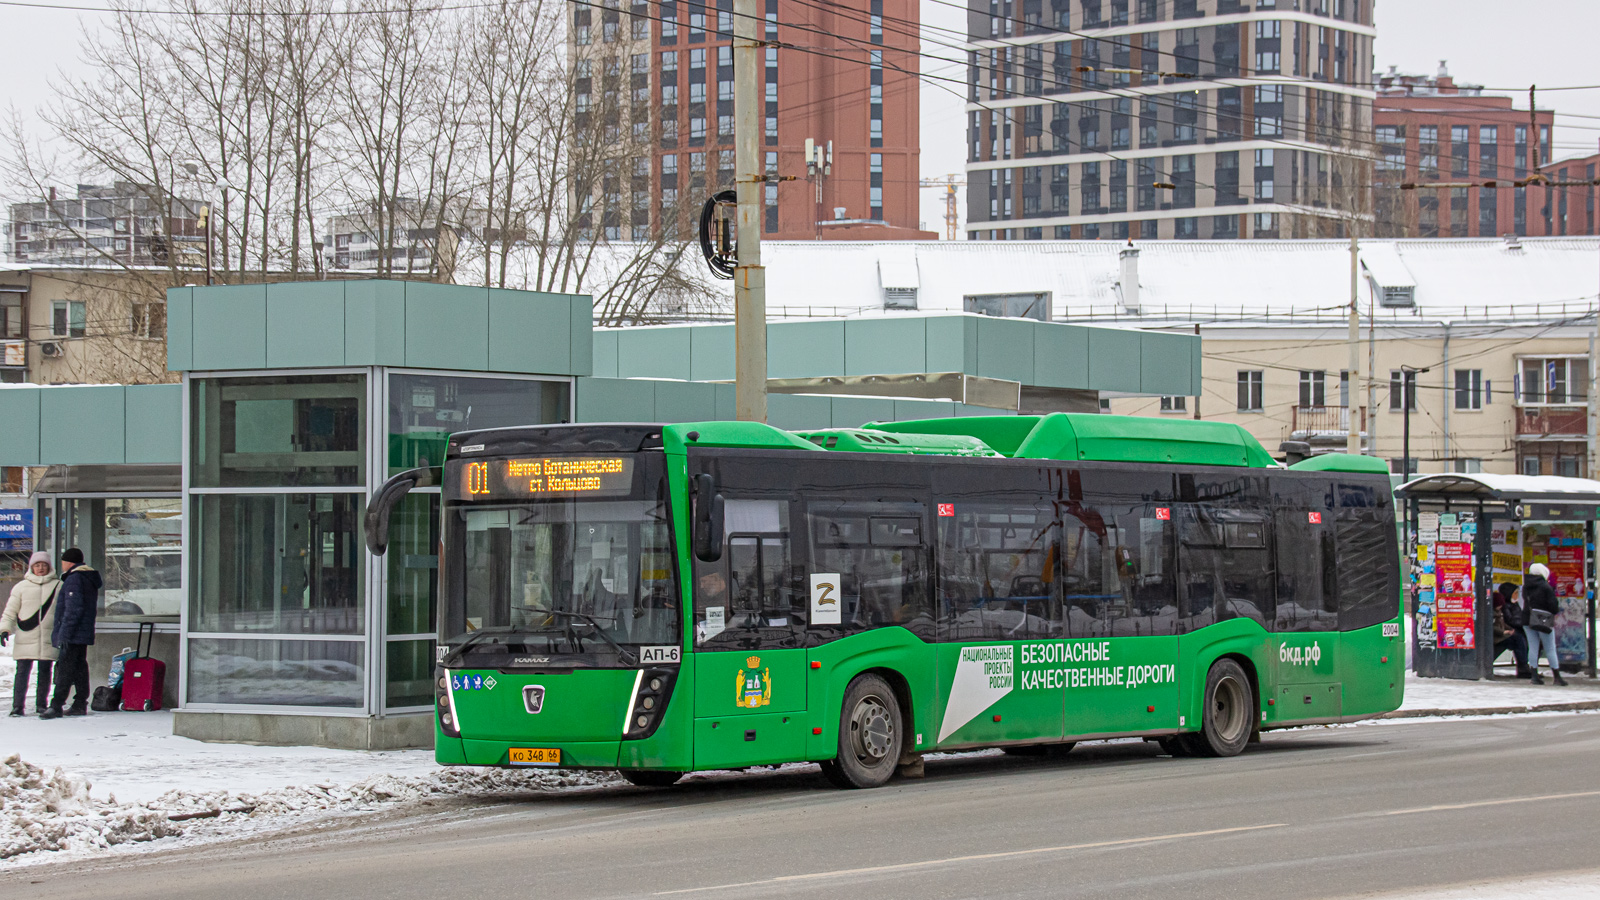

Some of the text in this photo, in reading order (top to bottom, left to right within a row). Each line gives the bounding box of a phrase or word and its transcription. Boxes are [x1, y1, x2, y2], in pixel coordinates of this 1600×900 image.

[509, 458, 623, 477] Метро Ботаническая
[468, 462, 491, 494] 01
[529, 476, 601, 492] ст. Кольцово
[815, 582, 836, 606] Z
[1383, 625, 1398, 635] 2004
[642, 647, 678, 661] АП-6
[962, 647, 1012, 662] НАЦИОНАЛЬНЫЕ
[1021, 641, 1110, 664] БЕЗОПАСНЫЕ
[1279, 641, 1321, 666] бкд.рф
[984, 661, 1012, 675] ПРОЕКТЫ
[989, 674, 1012, 689] РОССИИ
[1021, 664, 1175, 690] КАЧЕСТВЕННЫЕ ДОРОГИ
[527, 750, 544, 761] 348
[548, 750, 557, 758] 66
